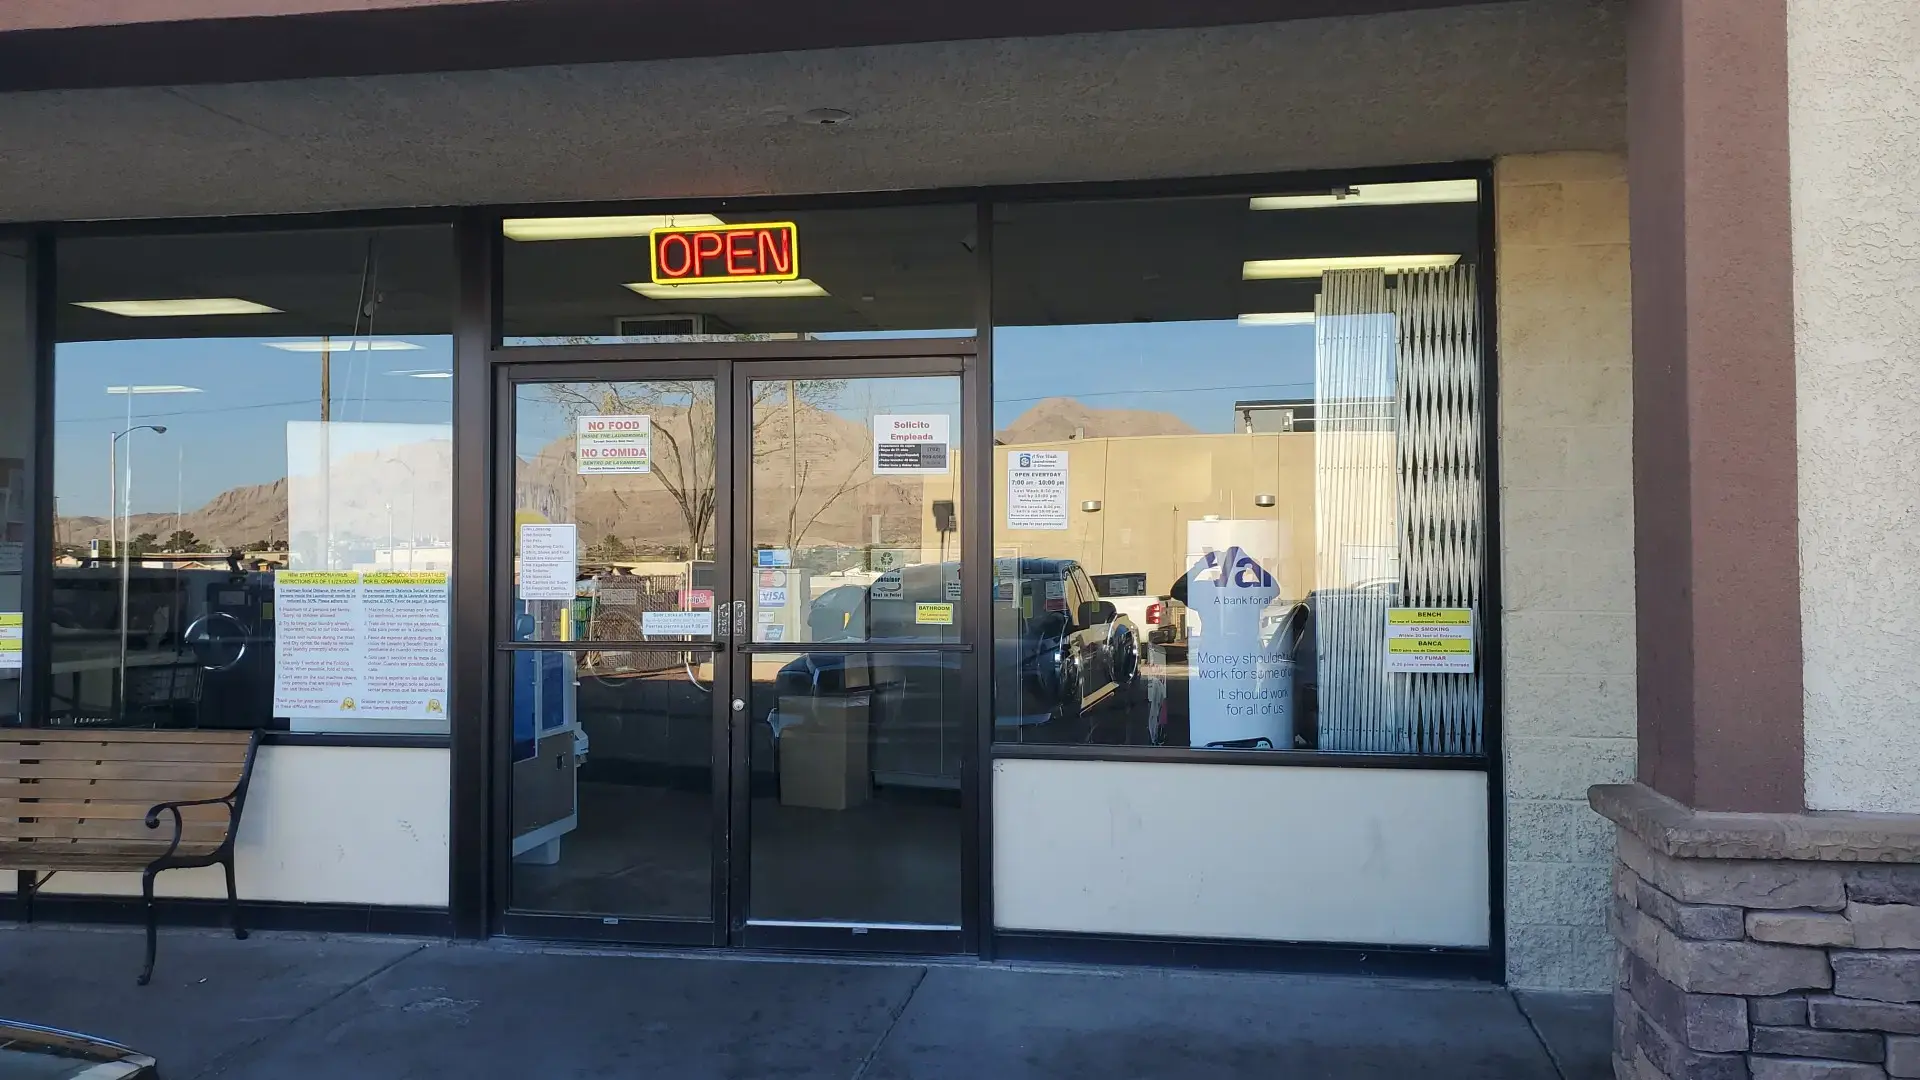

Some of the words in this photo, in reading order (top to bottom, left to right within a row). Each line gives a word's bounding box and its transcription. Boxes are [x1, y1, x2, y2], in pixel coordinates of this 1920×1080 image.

[660, 229, 788, 277] OPEN
[588, 422, 605, 430] NO
[609, 422, 640, 430] FOOD
[894, 421, 930, 429] Solicito
[581, 448, 598, 457] NO
[602, 448, 647, 457] COMIDA
[762, 592, 785, 601] VISA
[1214, 596, 1221, 605] A
[1224, 596, 1248, 605] bank
[1249, 596, 1262, 605] for
[1264, 596, 1272, 605] all
[1197, 652, 1240, 666] Money
[1199, 668, 1228, 679] work
[1231, 668, 1248, 679] for
[1251, 669, 1279, 679] some
[1218, 688, 1225, 700] It
[1229, 688, 1268, 700] should
[1270, 689, 1289, 699] work
[1226, 704, 1243, 716] for
[1246, 704, 1258, 716] all
[1261, 704, 1272, 716] of
